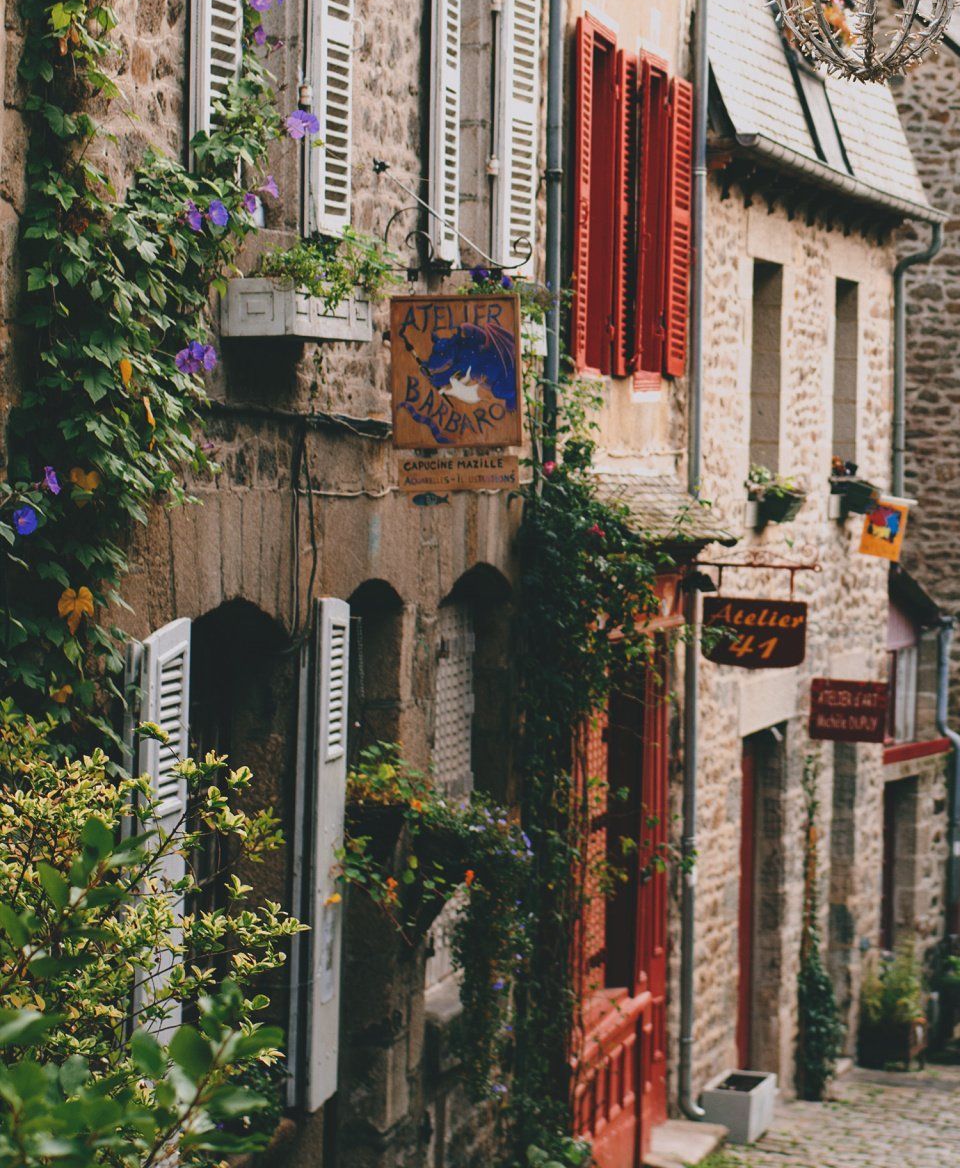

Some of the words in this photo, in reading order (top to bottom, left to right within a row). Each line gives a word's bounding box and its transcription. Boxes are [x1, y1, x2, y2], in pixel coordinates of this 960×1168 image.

[399, 303, 503, 334] ATELIER
[404, 375, 506, 435] BARBARO
[705, 603, 805, 629] Atelier
[728, 634, 779, 660] 41
